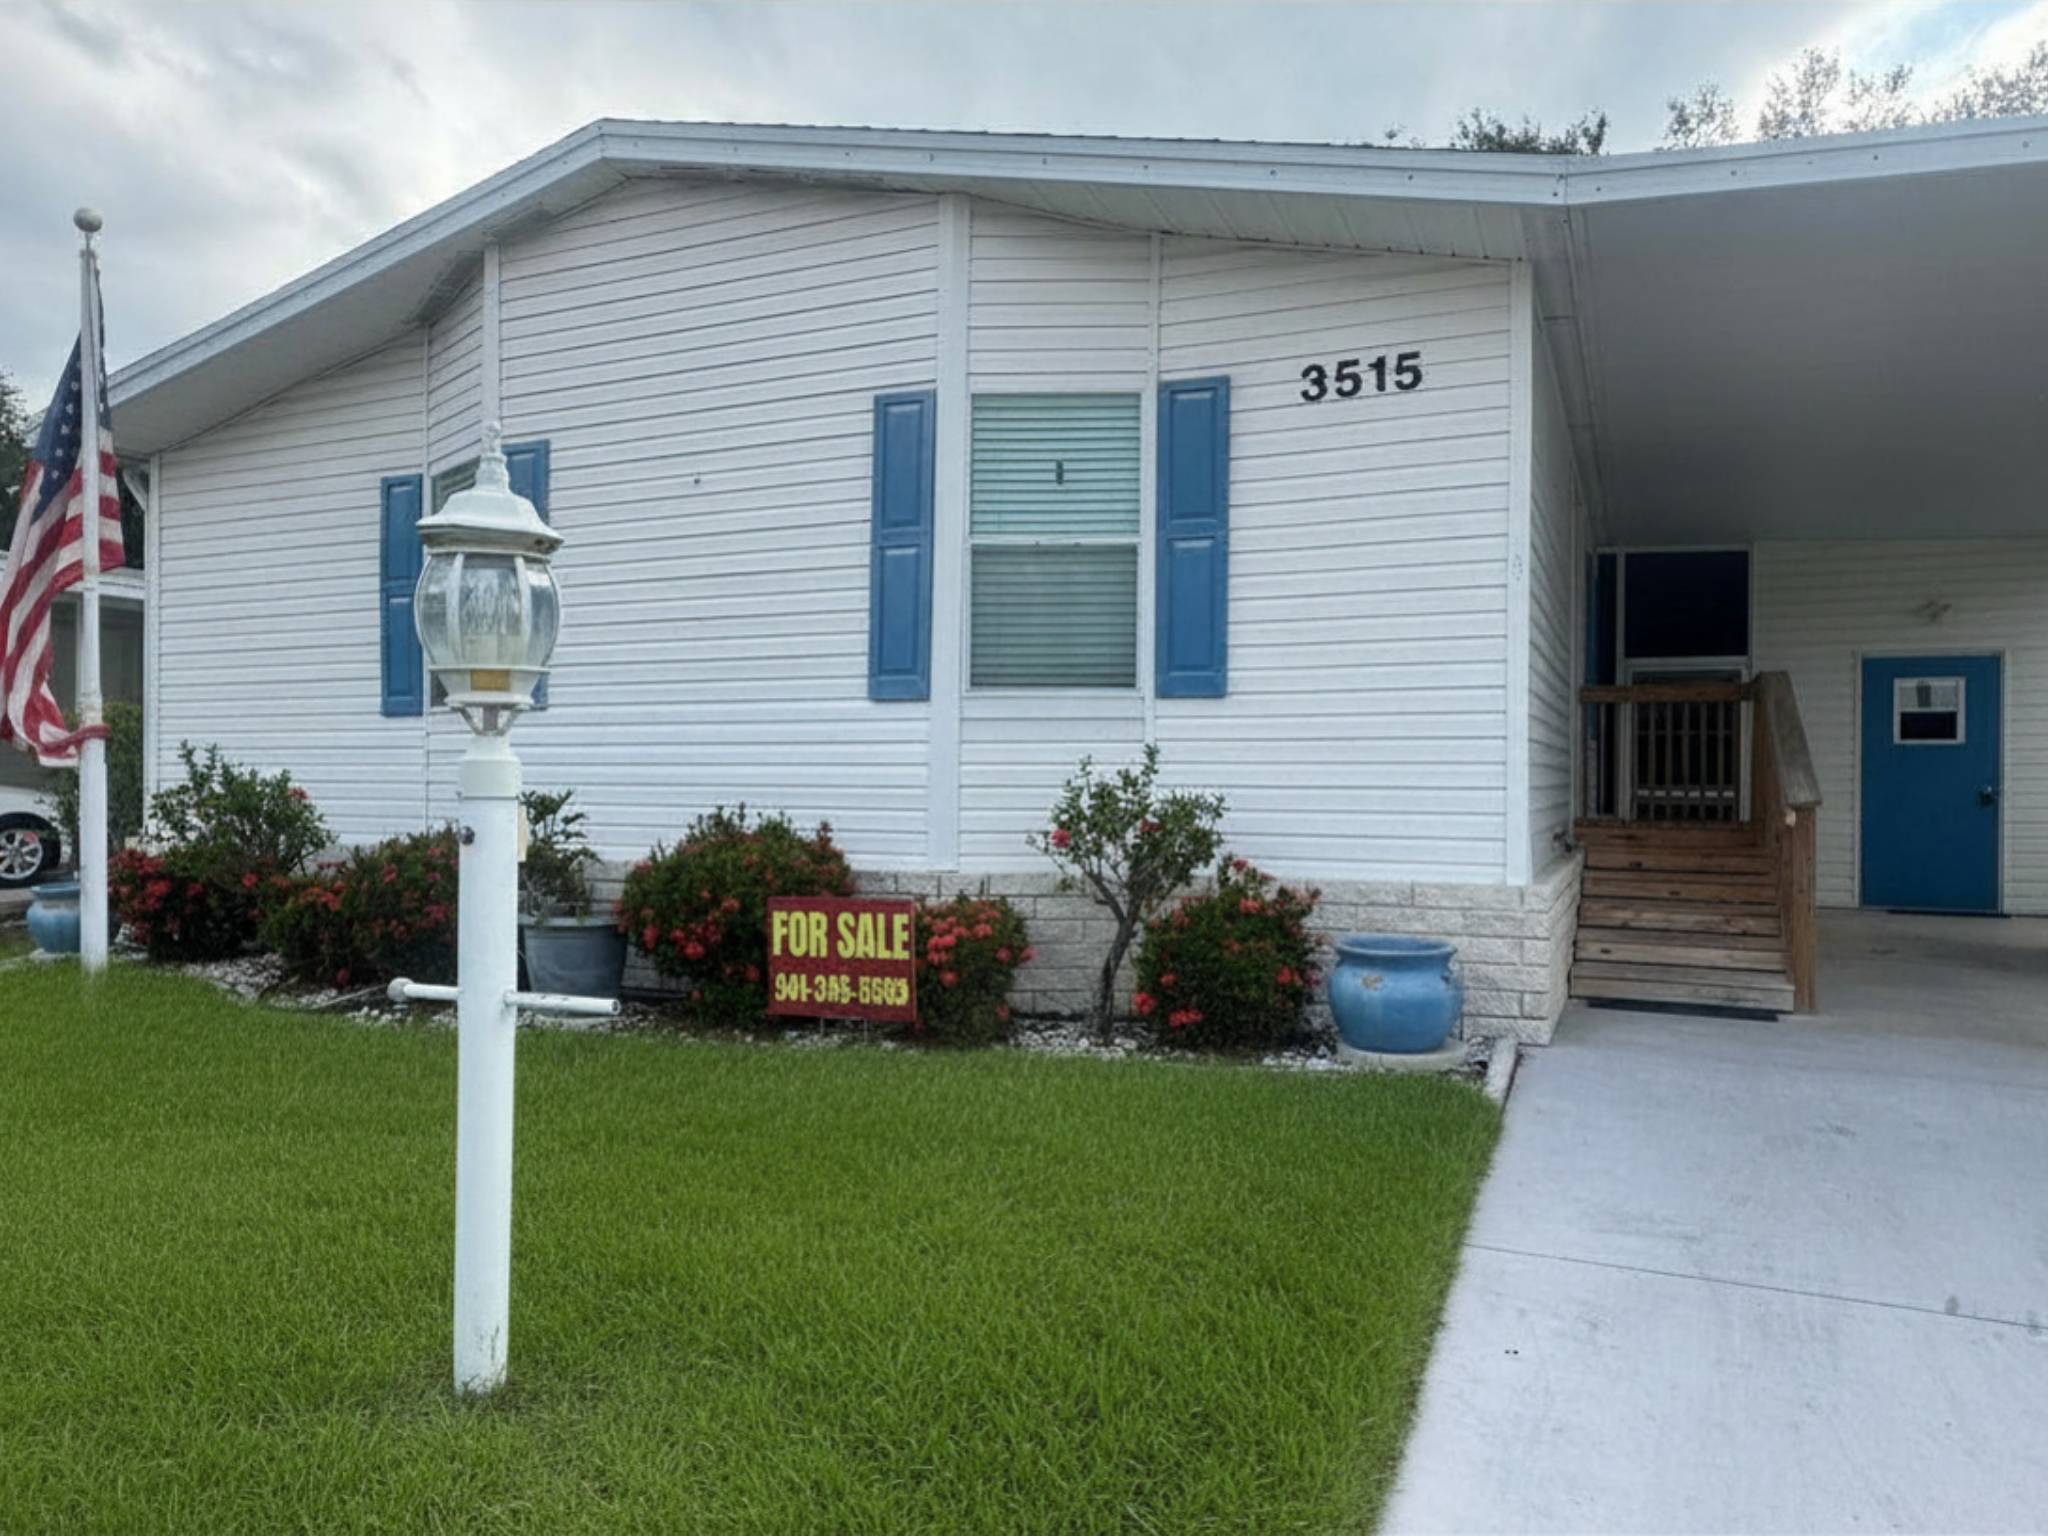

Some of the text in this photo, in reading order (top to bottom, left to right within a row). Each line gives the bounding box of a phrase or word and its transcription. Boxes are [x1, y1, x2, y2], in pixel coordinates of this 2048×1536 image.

[1301, 350, 1423, 402] 3515
[772, 911, 910, 960] FOR SALE
